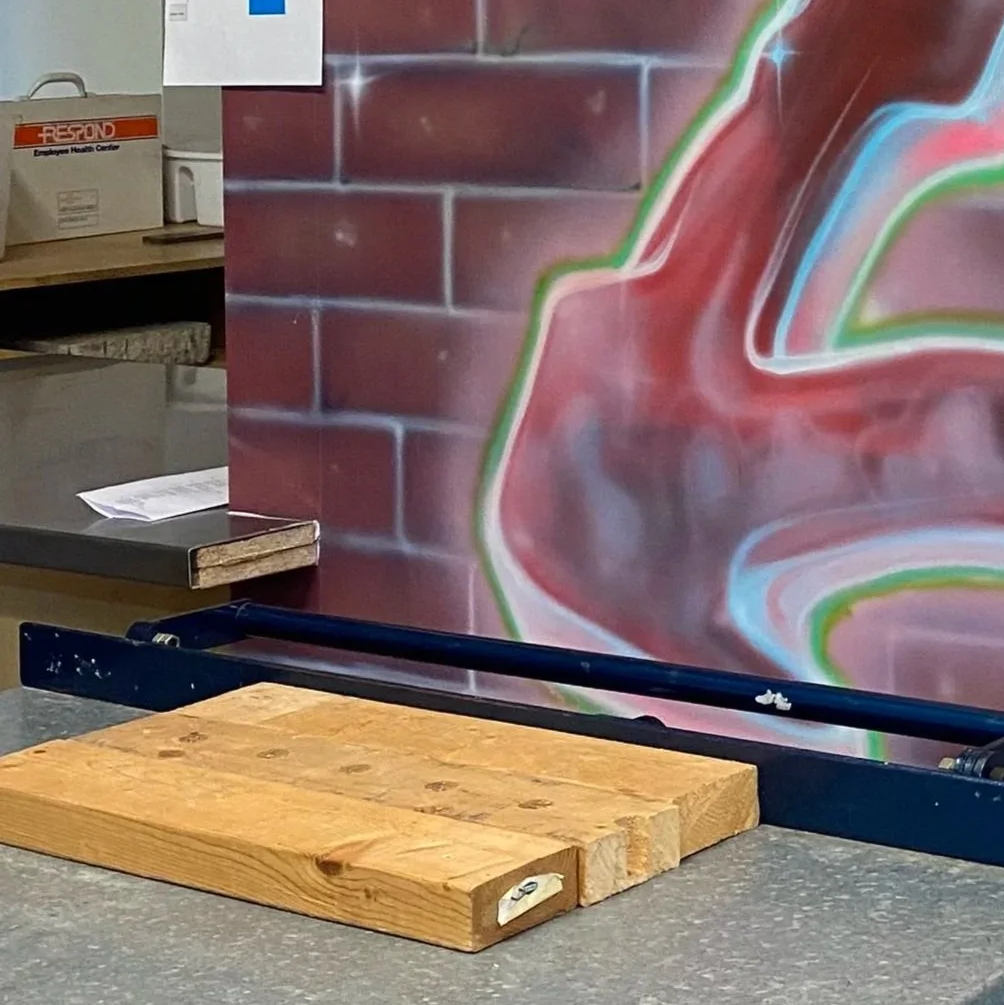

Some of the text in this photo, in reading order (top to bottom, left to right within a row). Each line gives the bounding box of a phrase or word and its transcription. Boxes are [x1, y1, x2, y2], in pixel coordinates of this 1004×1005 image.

[38, 122, 116, 144] RESPOND
[33, 144, 120, 157] Employee Health Center
